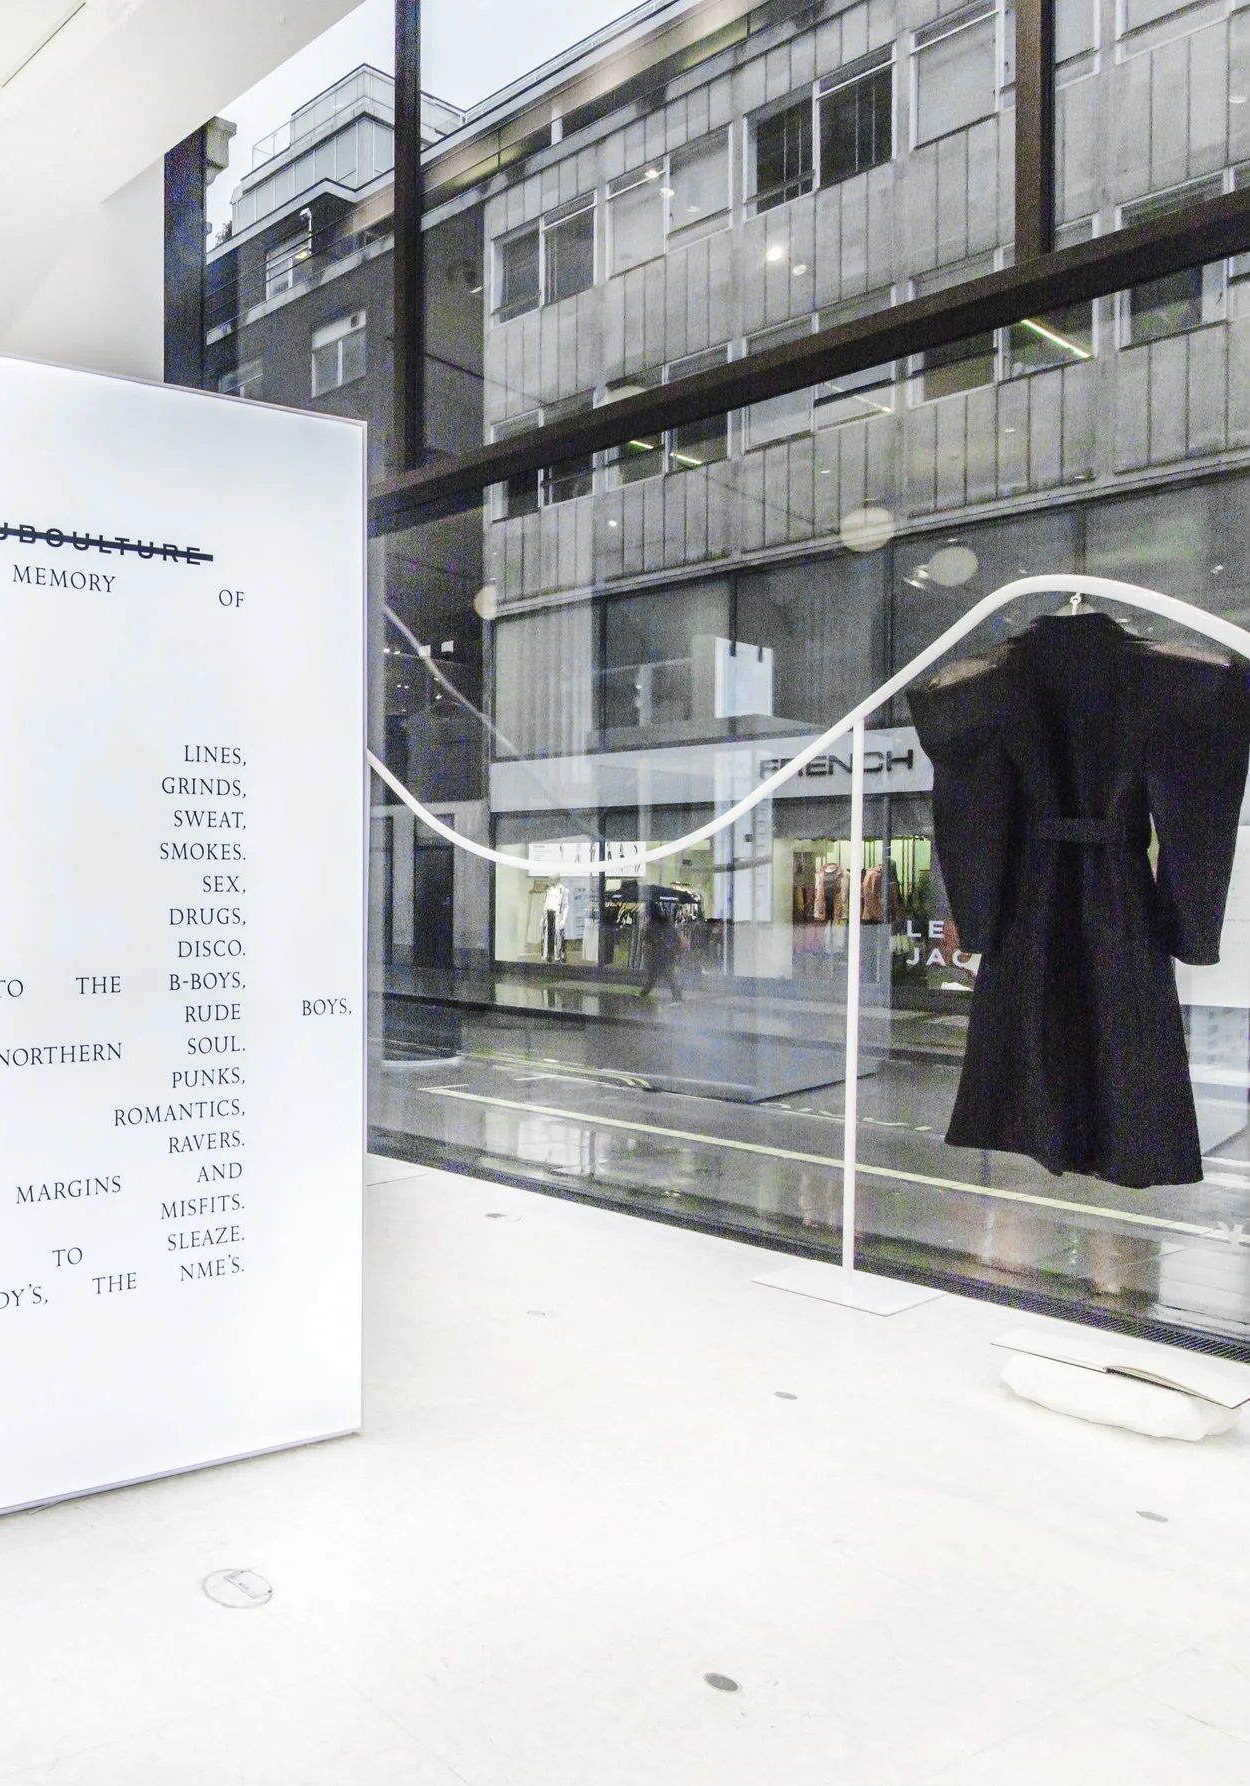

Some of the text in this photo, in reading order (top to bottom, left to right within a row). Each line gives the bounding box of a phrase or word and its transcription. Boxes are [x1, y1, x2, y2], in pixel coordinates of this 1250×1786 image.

[13, 565, 116, 592] MEMORY
[219, 590, 244, 607] OF
[184, 745, 246, 766] LINES,
[162, 777, 246, 798] GRINDS,
[174, 810, 246, 830] SWEAT,
[160, 843, 245, 860] SMOKES.
[203, 876, 245, 893] SEX,
[170, 908, 245, 925] DRUGS,
[178, 940, 245, 957] DISCO.
[76, 976, 121, 994] THE
[170, 972, 245, 990] B-BOYS,
[186, 1004, 240, 1022] RUDE
[303, 998, 351, 1016] BOYS,
[188, 1036, 245, 1055] SOUL.
[173, 1067, 245, 1088] PUNKS,
[114, 1099, 244, 1126] ROMANTICS,
[169, 1131, 244, 1153] RAVERS.
[17, 1176, 121, 1204] MARGINS
[198, 1163, 242, 1182] AND
[161, 1194, 244, 1219] MISFITS.
[52, 1247, 82, 1267] TO
[168, 1225, 244, 1251] SLEAZE.
[92, 1272, 136, 1294] THE
